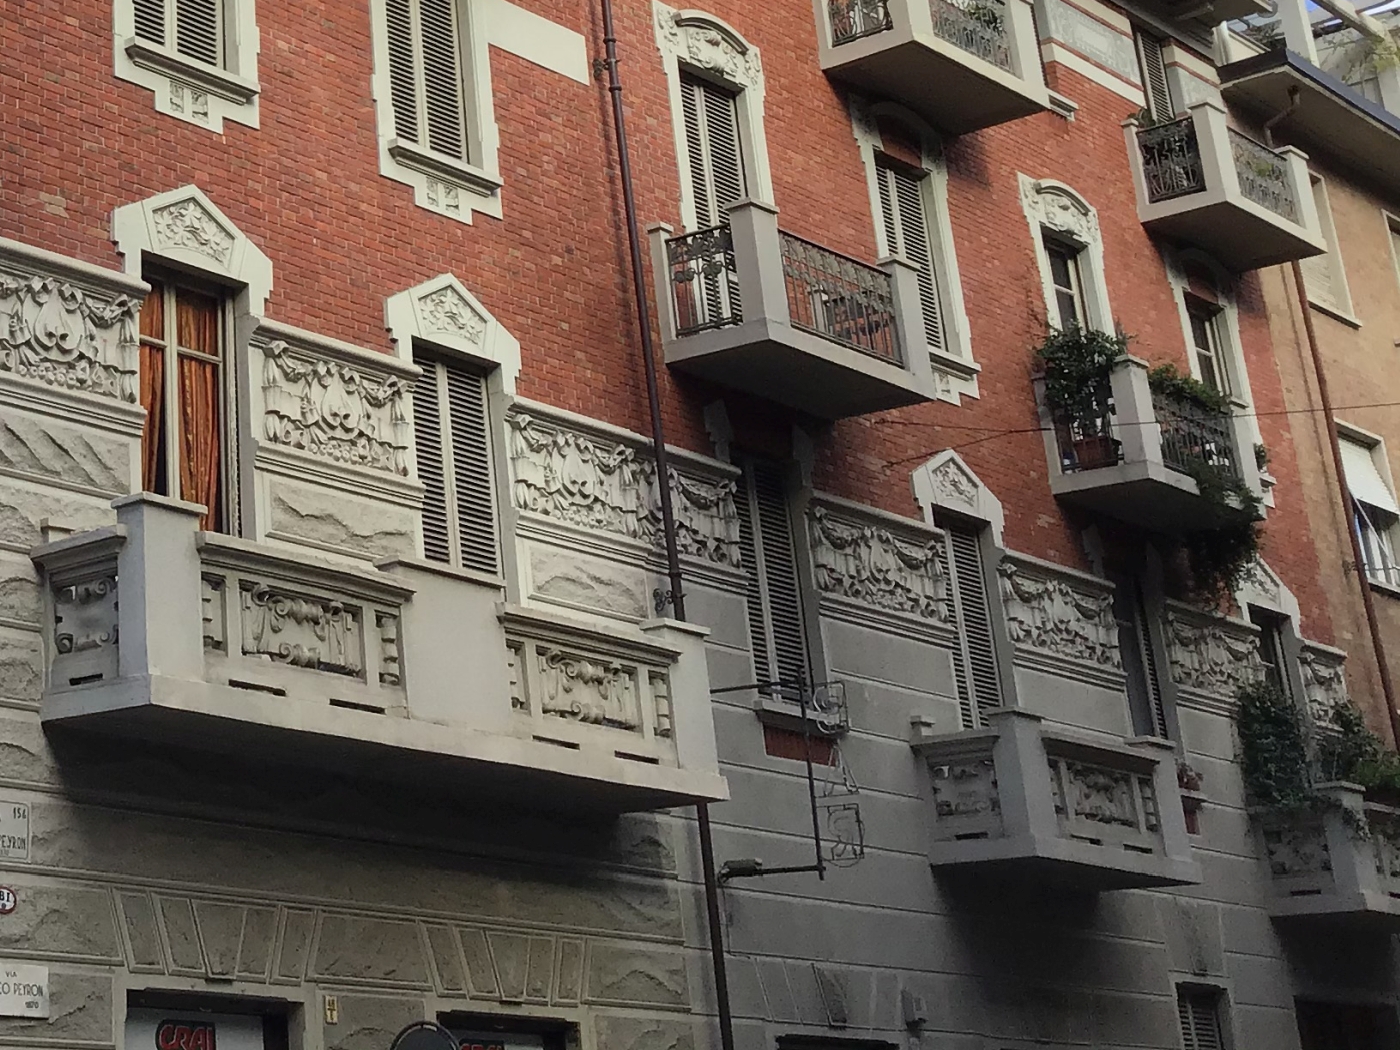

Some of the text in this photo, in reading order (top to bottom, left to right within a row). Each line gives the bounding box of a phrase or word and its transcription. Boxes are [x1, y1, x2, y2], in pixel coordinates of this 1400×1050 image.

[13, 807, 27, 819] 156
[13, 982, 43, 997] PEYRON
[159, 1024, 214, 1050] CRAI
